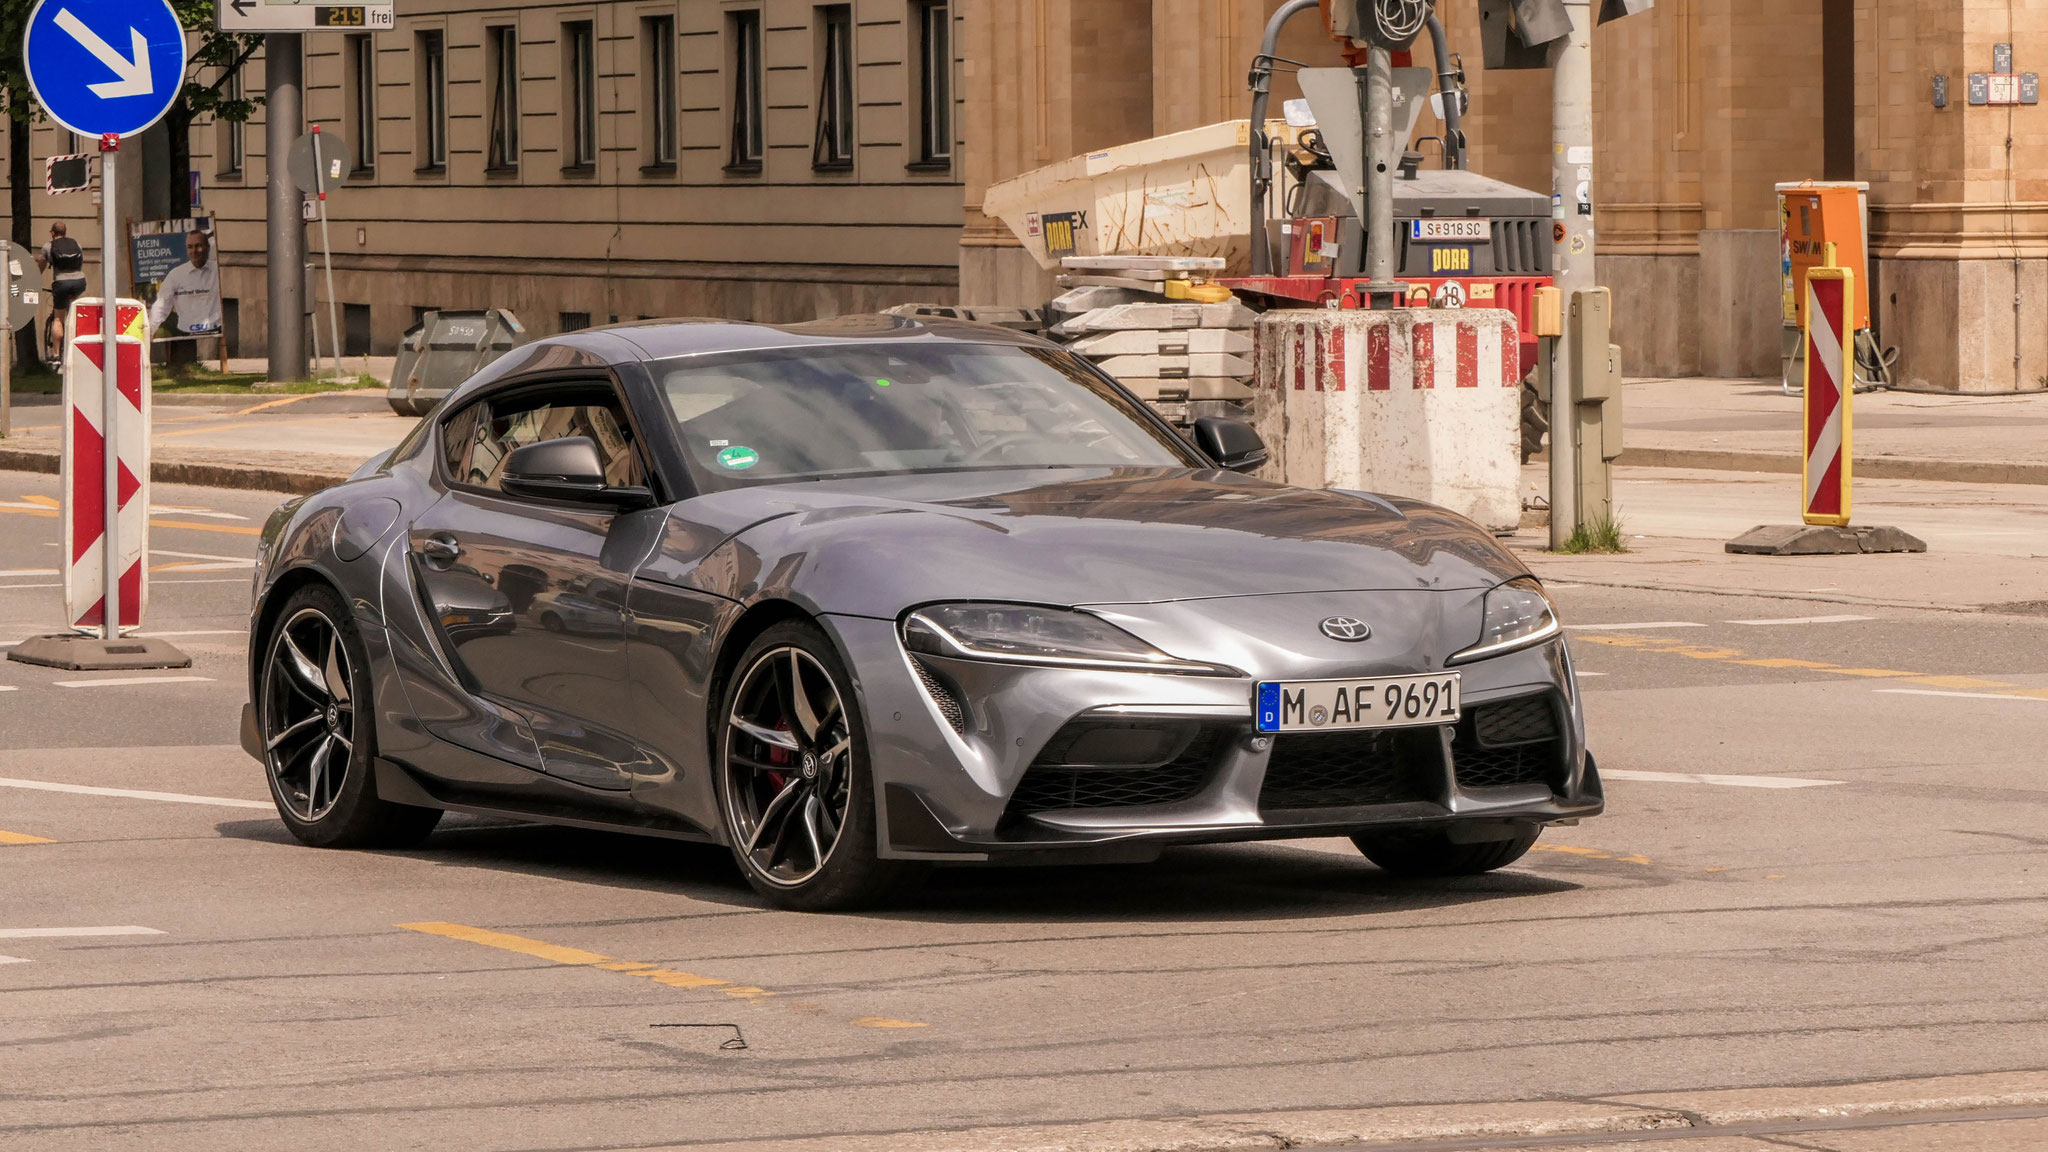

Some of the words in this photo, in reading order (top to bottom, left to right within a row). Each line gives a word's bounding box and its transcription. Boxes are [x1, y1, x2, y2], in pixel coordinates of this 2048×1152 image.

[329, 7, 362, 25] 219
[371, 9, 392, 24] frei
[1427, 222, 1434, 235] S
[1443, 221, 1464, 235] 918
[1466, 221, 1481, 235] SC
[137, 239, 160, 249] MEIN
[137, 247, 172, 259] EUROPA
[189, 323, 208, 331] CSU
[1282, 688, 1305, 725] M
[1331, 685, 1375, 723] AF
[1384, 680, 1456, 720] 9691
[1265, 712, 1273, 722] D
